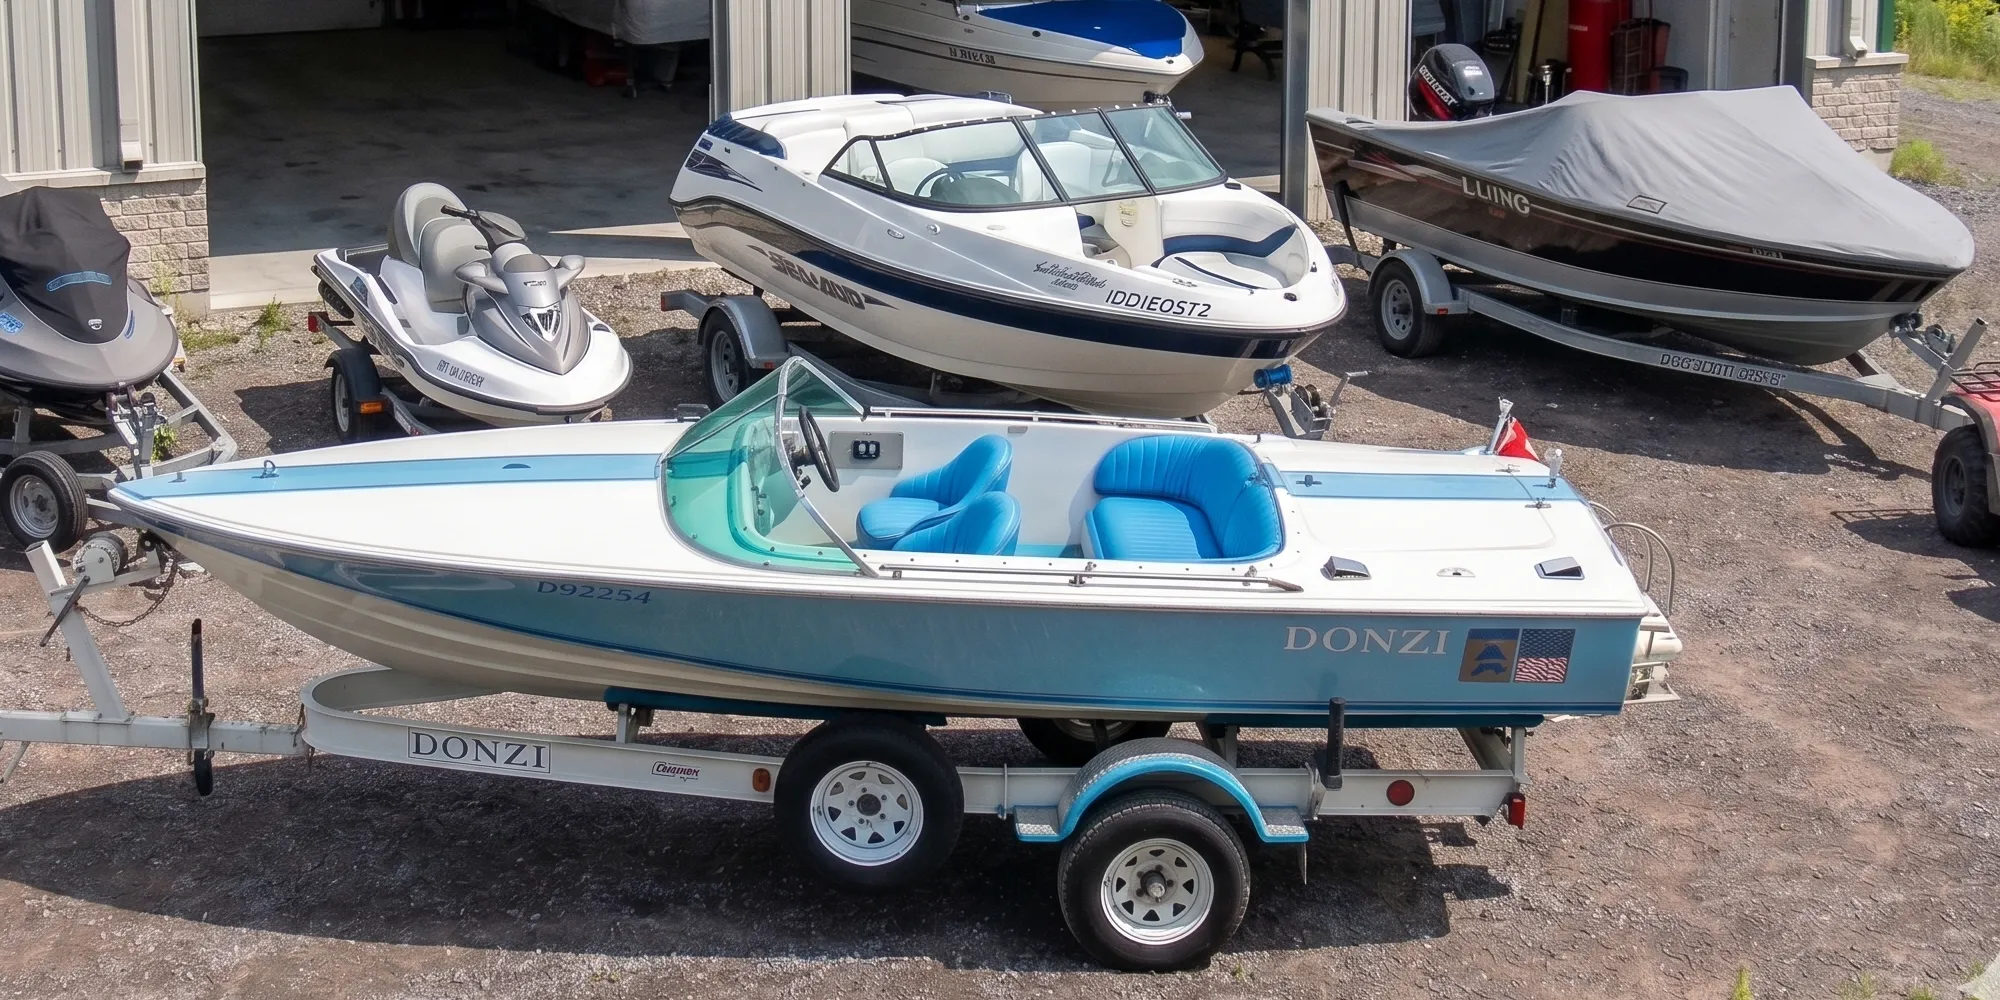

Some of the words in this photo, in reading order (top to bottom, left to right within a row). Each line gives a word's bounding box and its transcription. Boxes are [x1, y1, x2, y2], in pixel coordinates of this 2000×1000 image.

[537, 581, 652, 605] D92254
[1283, 626, 1450, 655] DONZI
[411, 731, 547, 769] DONZI
